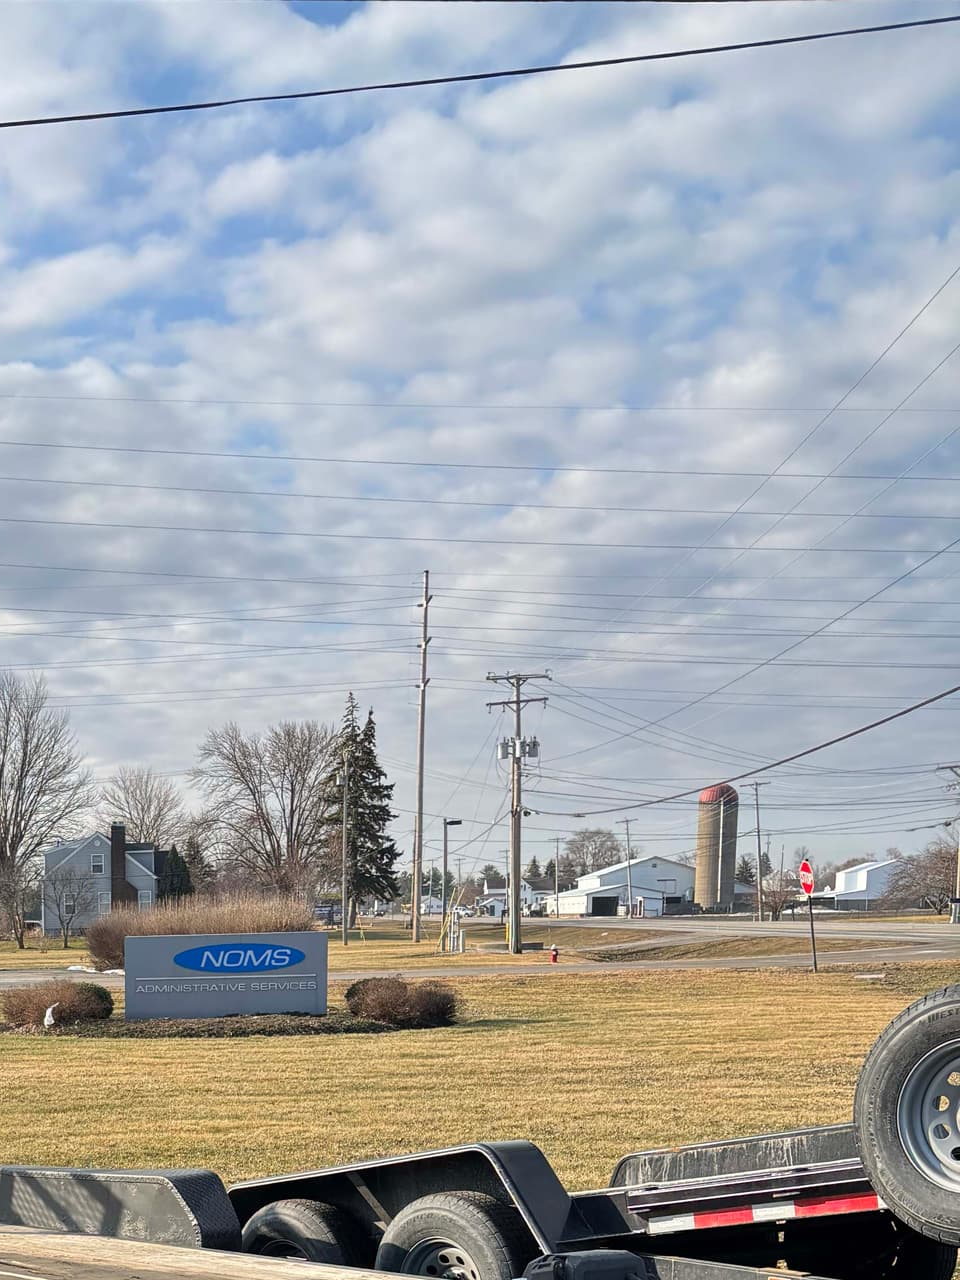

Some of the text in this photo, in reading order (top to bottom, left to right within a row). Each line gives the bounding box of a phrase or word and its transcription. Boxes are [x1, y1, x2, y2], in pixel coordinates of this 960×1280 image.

[200, 949, 291, 967] NOMS
[136, 981, 317, 993] ADMINISTRATIVE SERVICES
